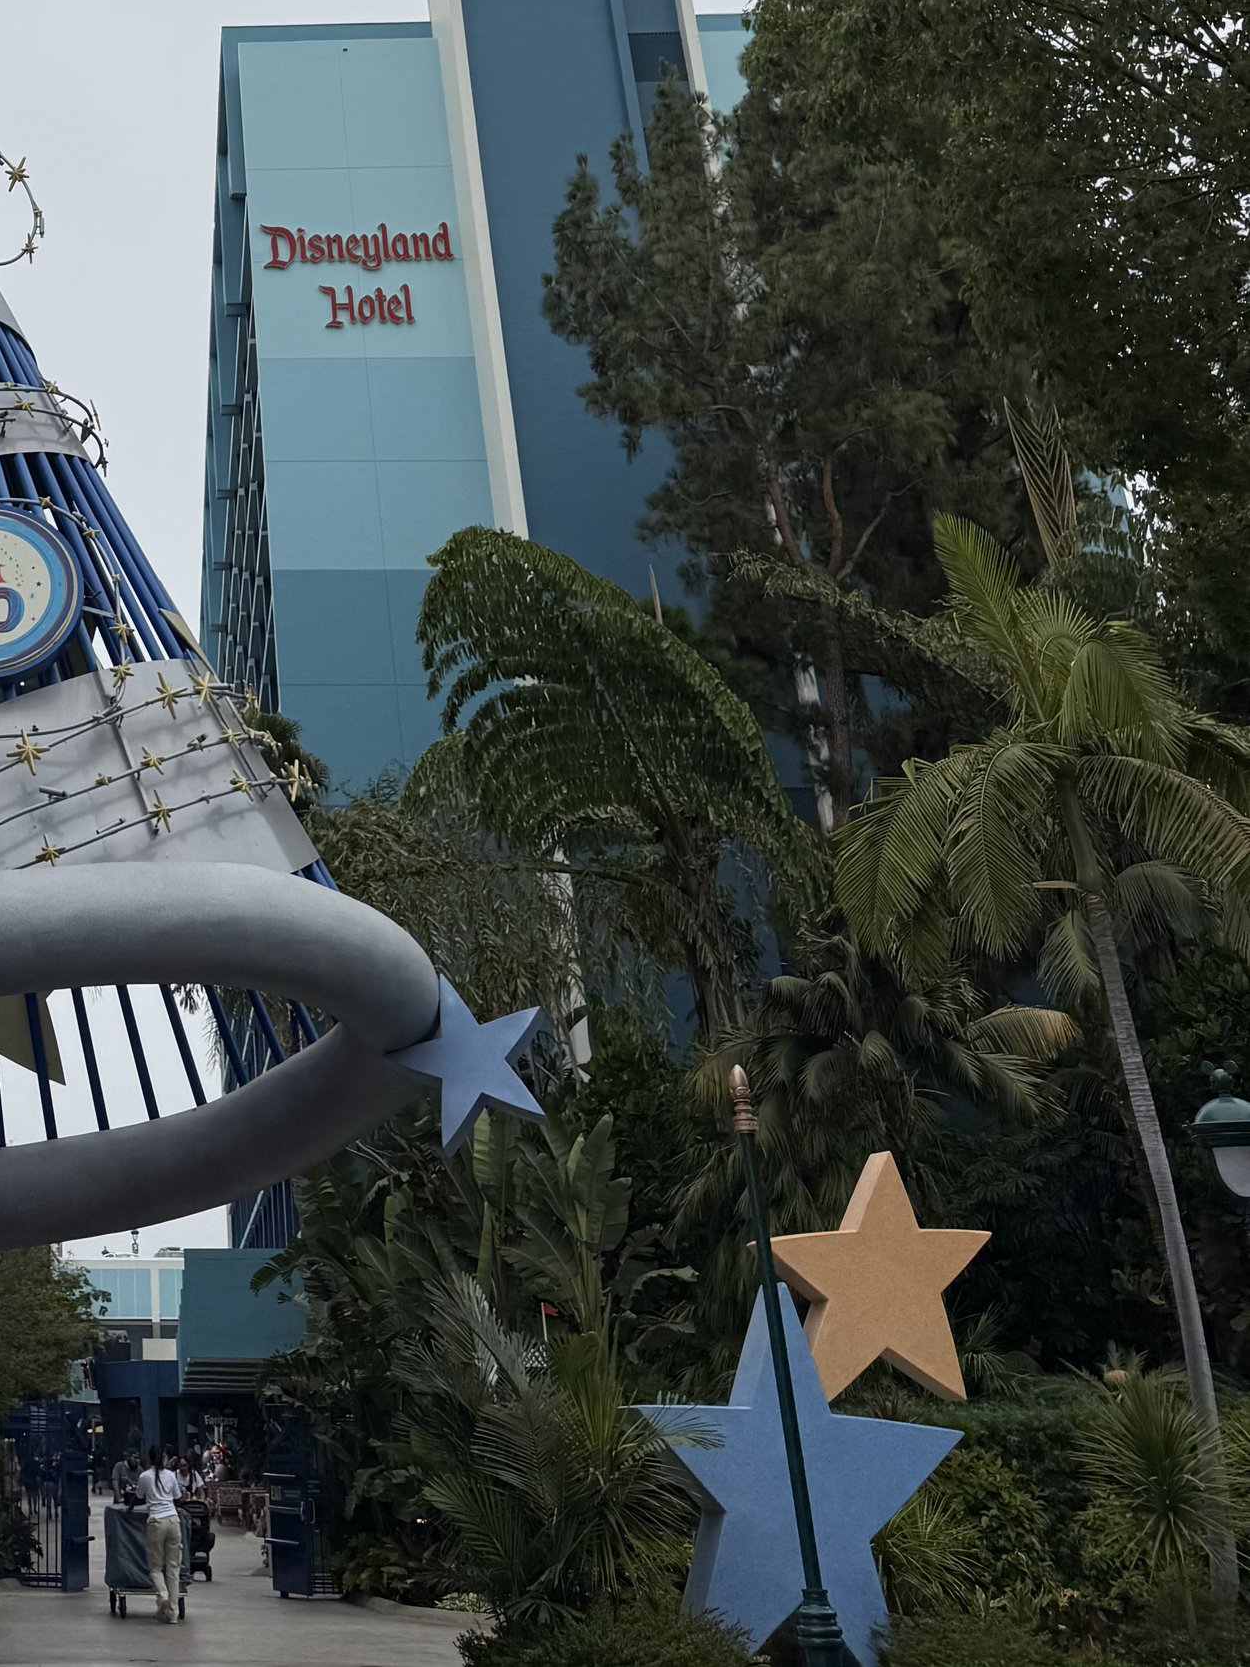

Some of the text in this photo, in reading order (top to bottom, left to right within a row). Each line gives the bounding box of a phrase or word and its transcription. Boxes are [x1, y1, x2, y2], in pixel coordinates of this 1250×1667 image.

[260, 221, 454, 270] Disneyland
[318, 283, 415, 328] Hotel
[204, 1414, 239, 1428] Fantasy
